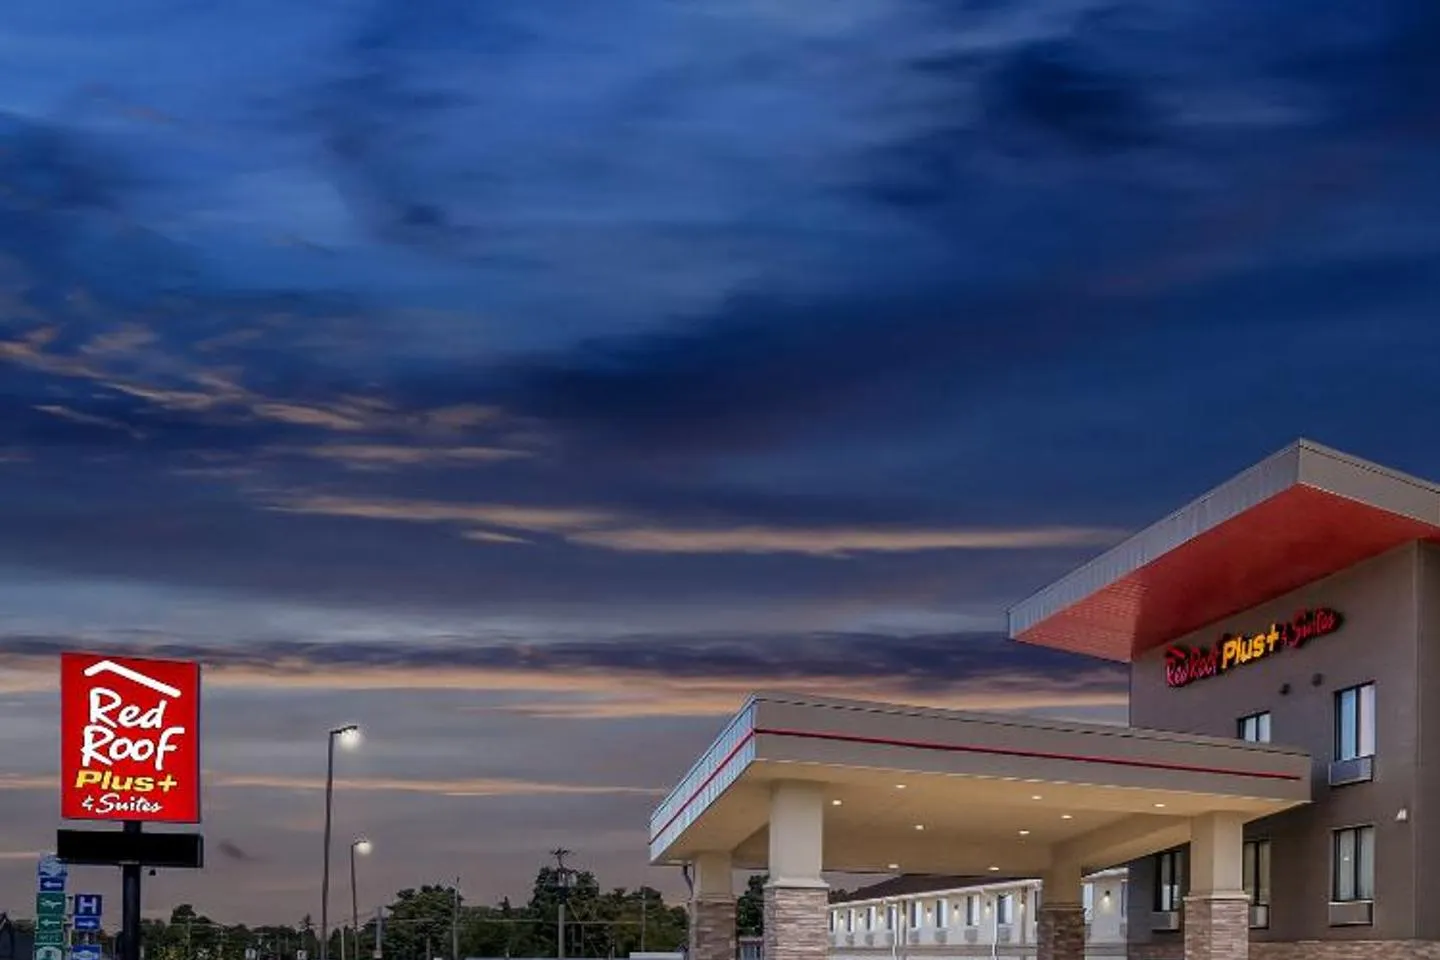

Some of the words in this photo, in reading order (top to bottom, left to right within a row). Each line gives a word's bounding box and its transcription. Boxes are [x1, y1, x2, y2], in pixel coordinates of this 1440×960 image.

[1221, 623, 1280, 669] Plus+
[89, 686, 167, 729] Red
[81, 725, 185, 771] Roof
[75, 770, 178, 793] Plus+
[95, 793, 163, 814] Suites
[79, 896, 97, 914] H
